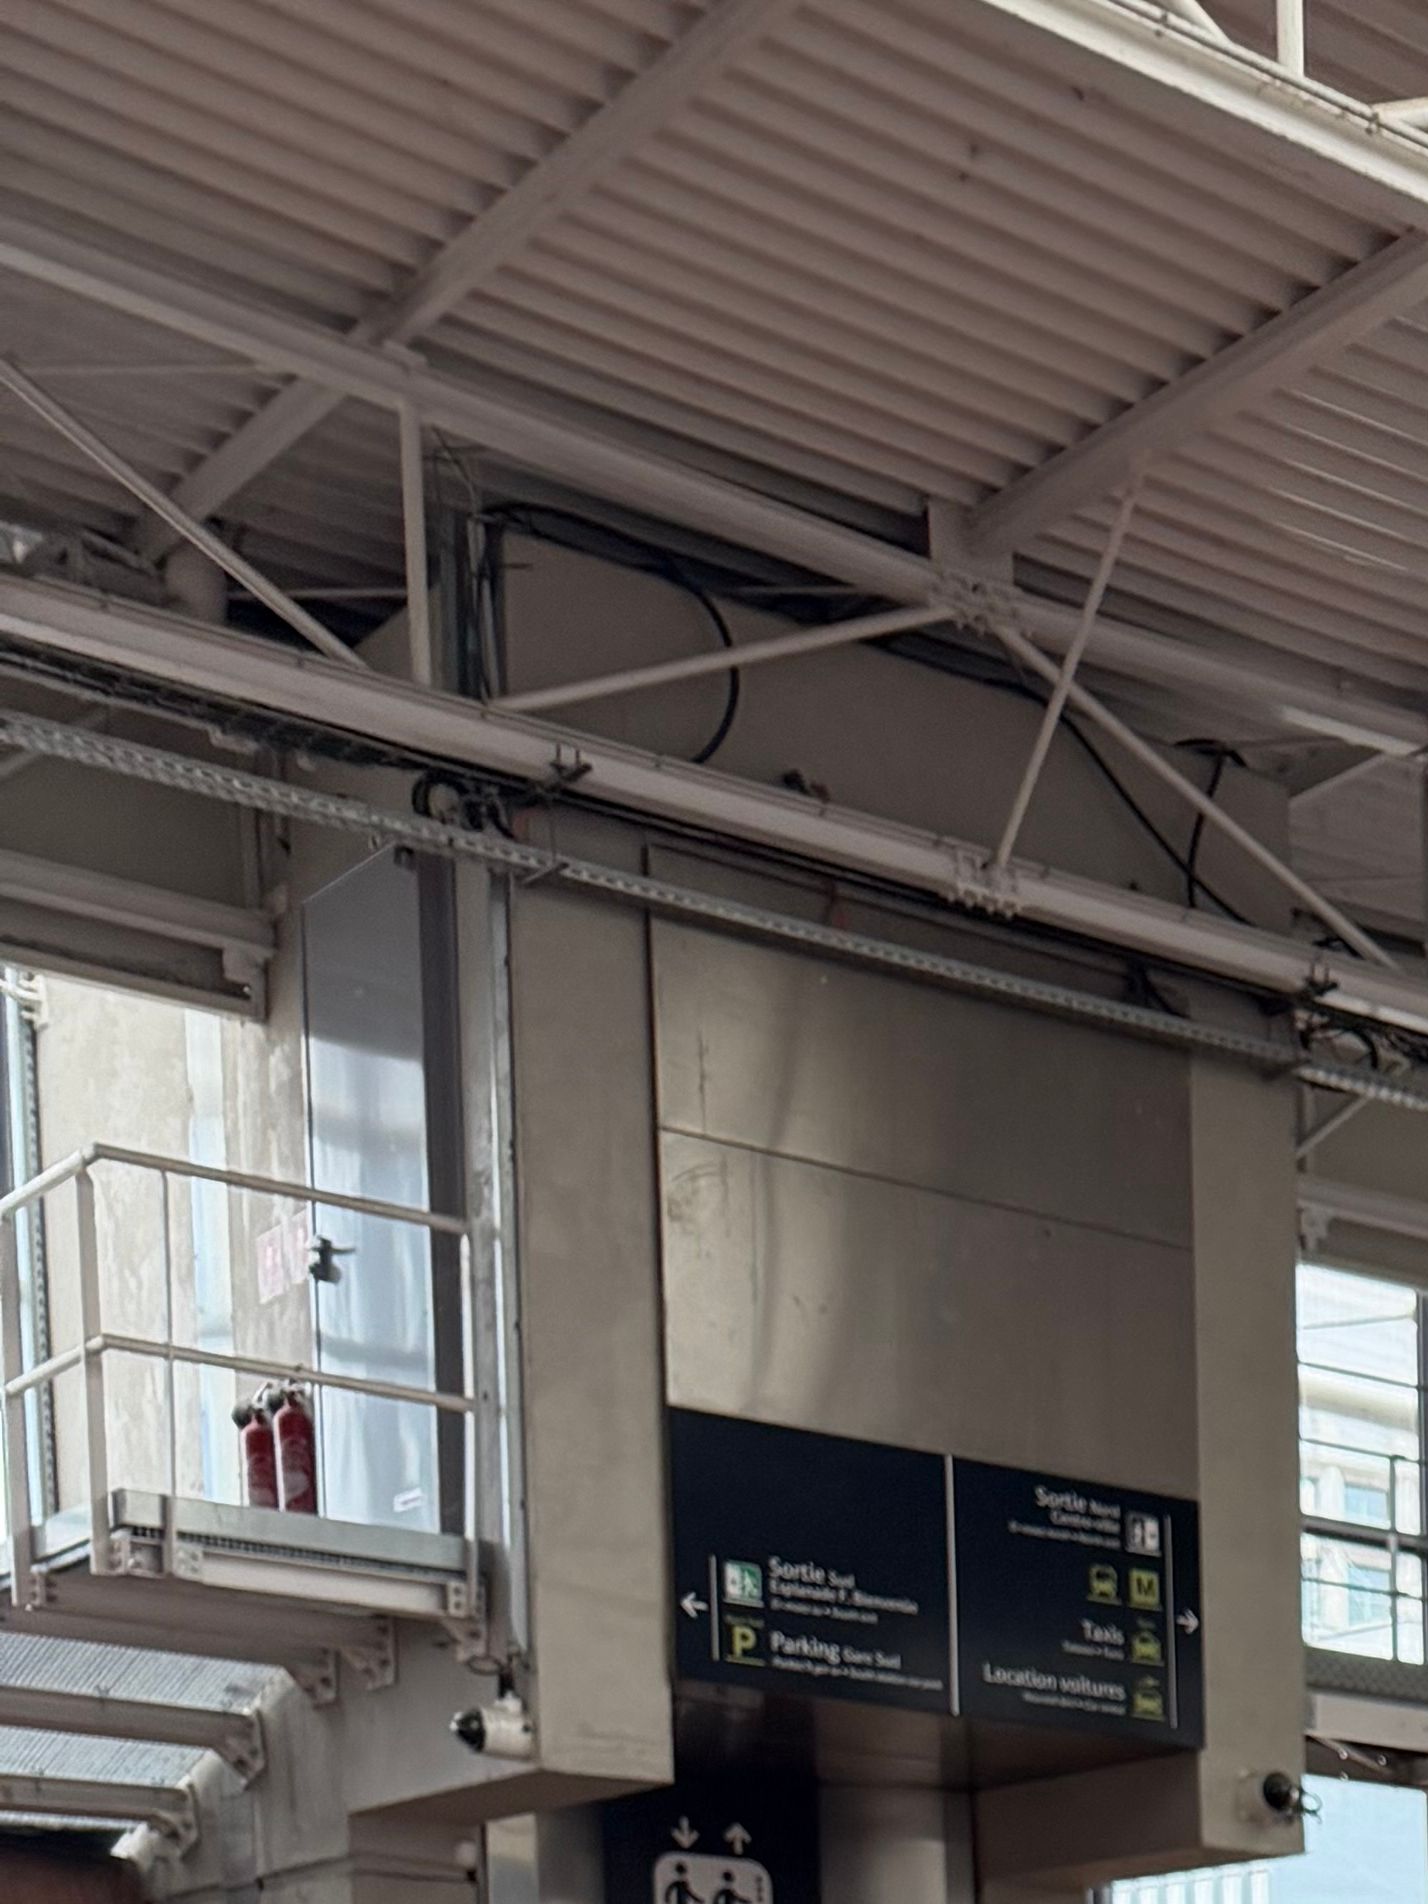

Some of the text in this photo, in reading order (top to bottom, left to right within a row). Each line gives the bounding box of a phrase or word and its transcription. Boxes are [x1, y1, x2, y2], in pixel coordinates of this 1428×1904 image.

[1034, 1485, 1087, 1513] Sortie
[768, 1555, 825, 1586] Sortie
[1137, 1577, 1156, 1597] M
[731, 1625, 756, 1657] P
[1081, 1618, 1124, 1645] Taxis
[770, 1631, 841, 1665] Parking
[983, 1663, 1126, 1700] Location voitures
